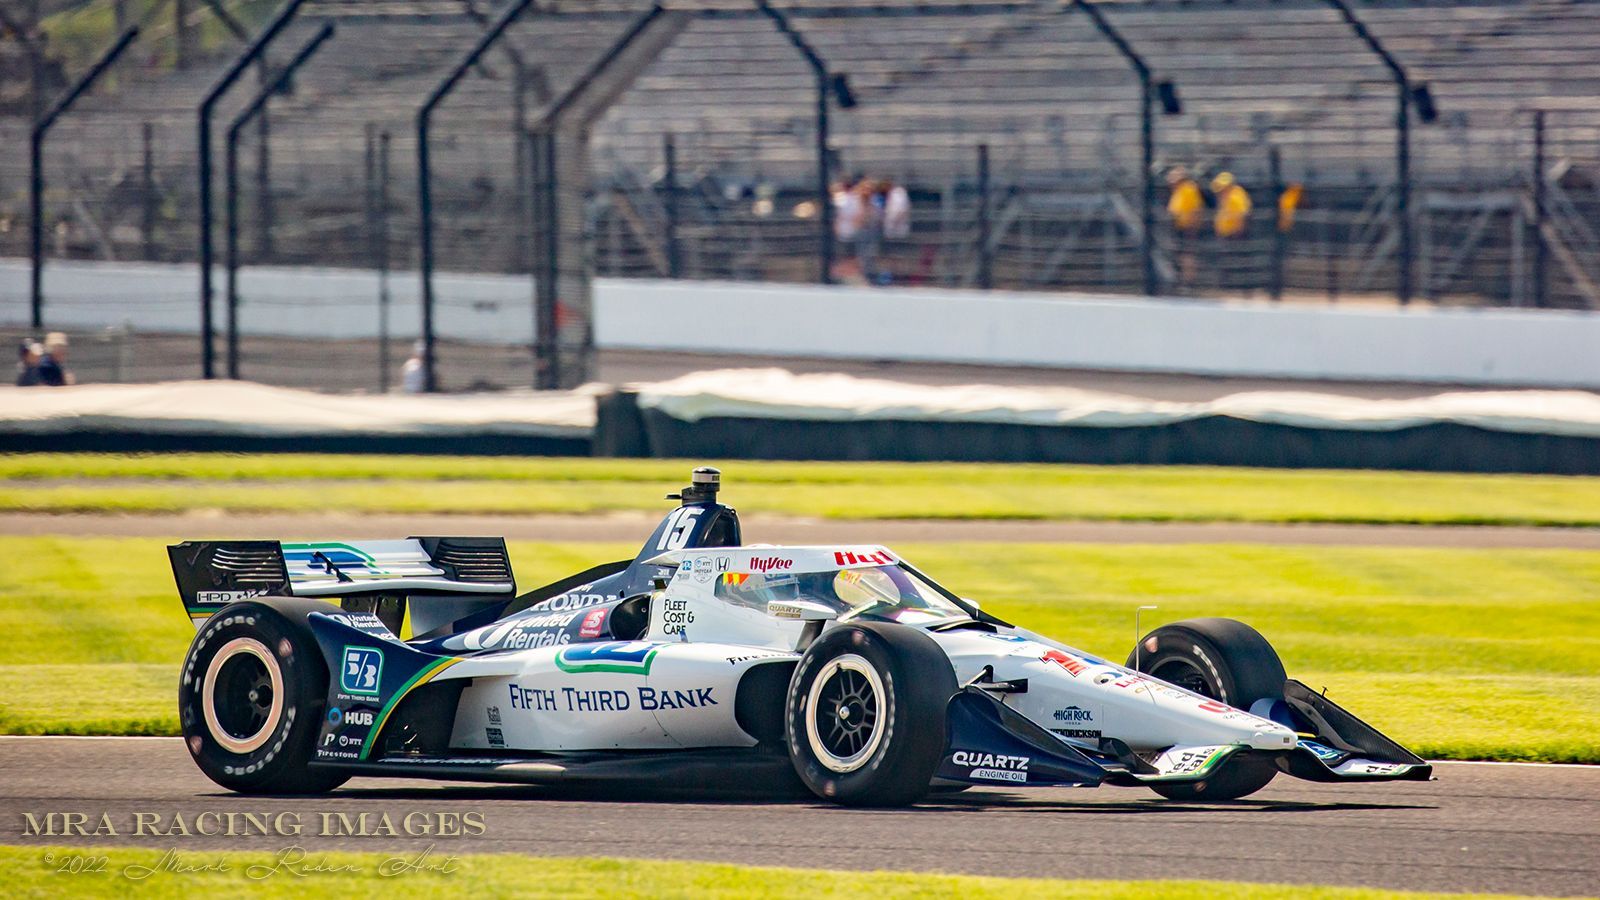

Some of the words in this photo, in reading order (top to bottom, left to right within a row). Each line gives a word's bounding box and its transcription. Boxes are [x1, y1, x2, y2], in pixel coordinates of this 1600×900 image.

[656, 506, 705, 550] 15
[750, 557, 793, 573] HyVee
[198, 592, 232, 602] HPD
[769, 605, 803, 614] QUARTZ
[516, 610, 580, 628] United
[687, 611, 695, 623] &
[502, 627, 571, 649] Rentals
[637, 686, 718, 711] BANK
[345, 712, 373, 726] HUB
[1053, 710, 1073, 721] HIGH
[1073, 710, 1093, 721] ROCK
[349, 738, 362, 746] NTT
[317, 749, 358, 758] Firestone
[952, 751, 1030, 770] QUARTZ
[980, 770, 1010, 780] ENGINE
[1011, 772, 1025, 781] OIL
